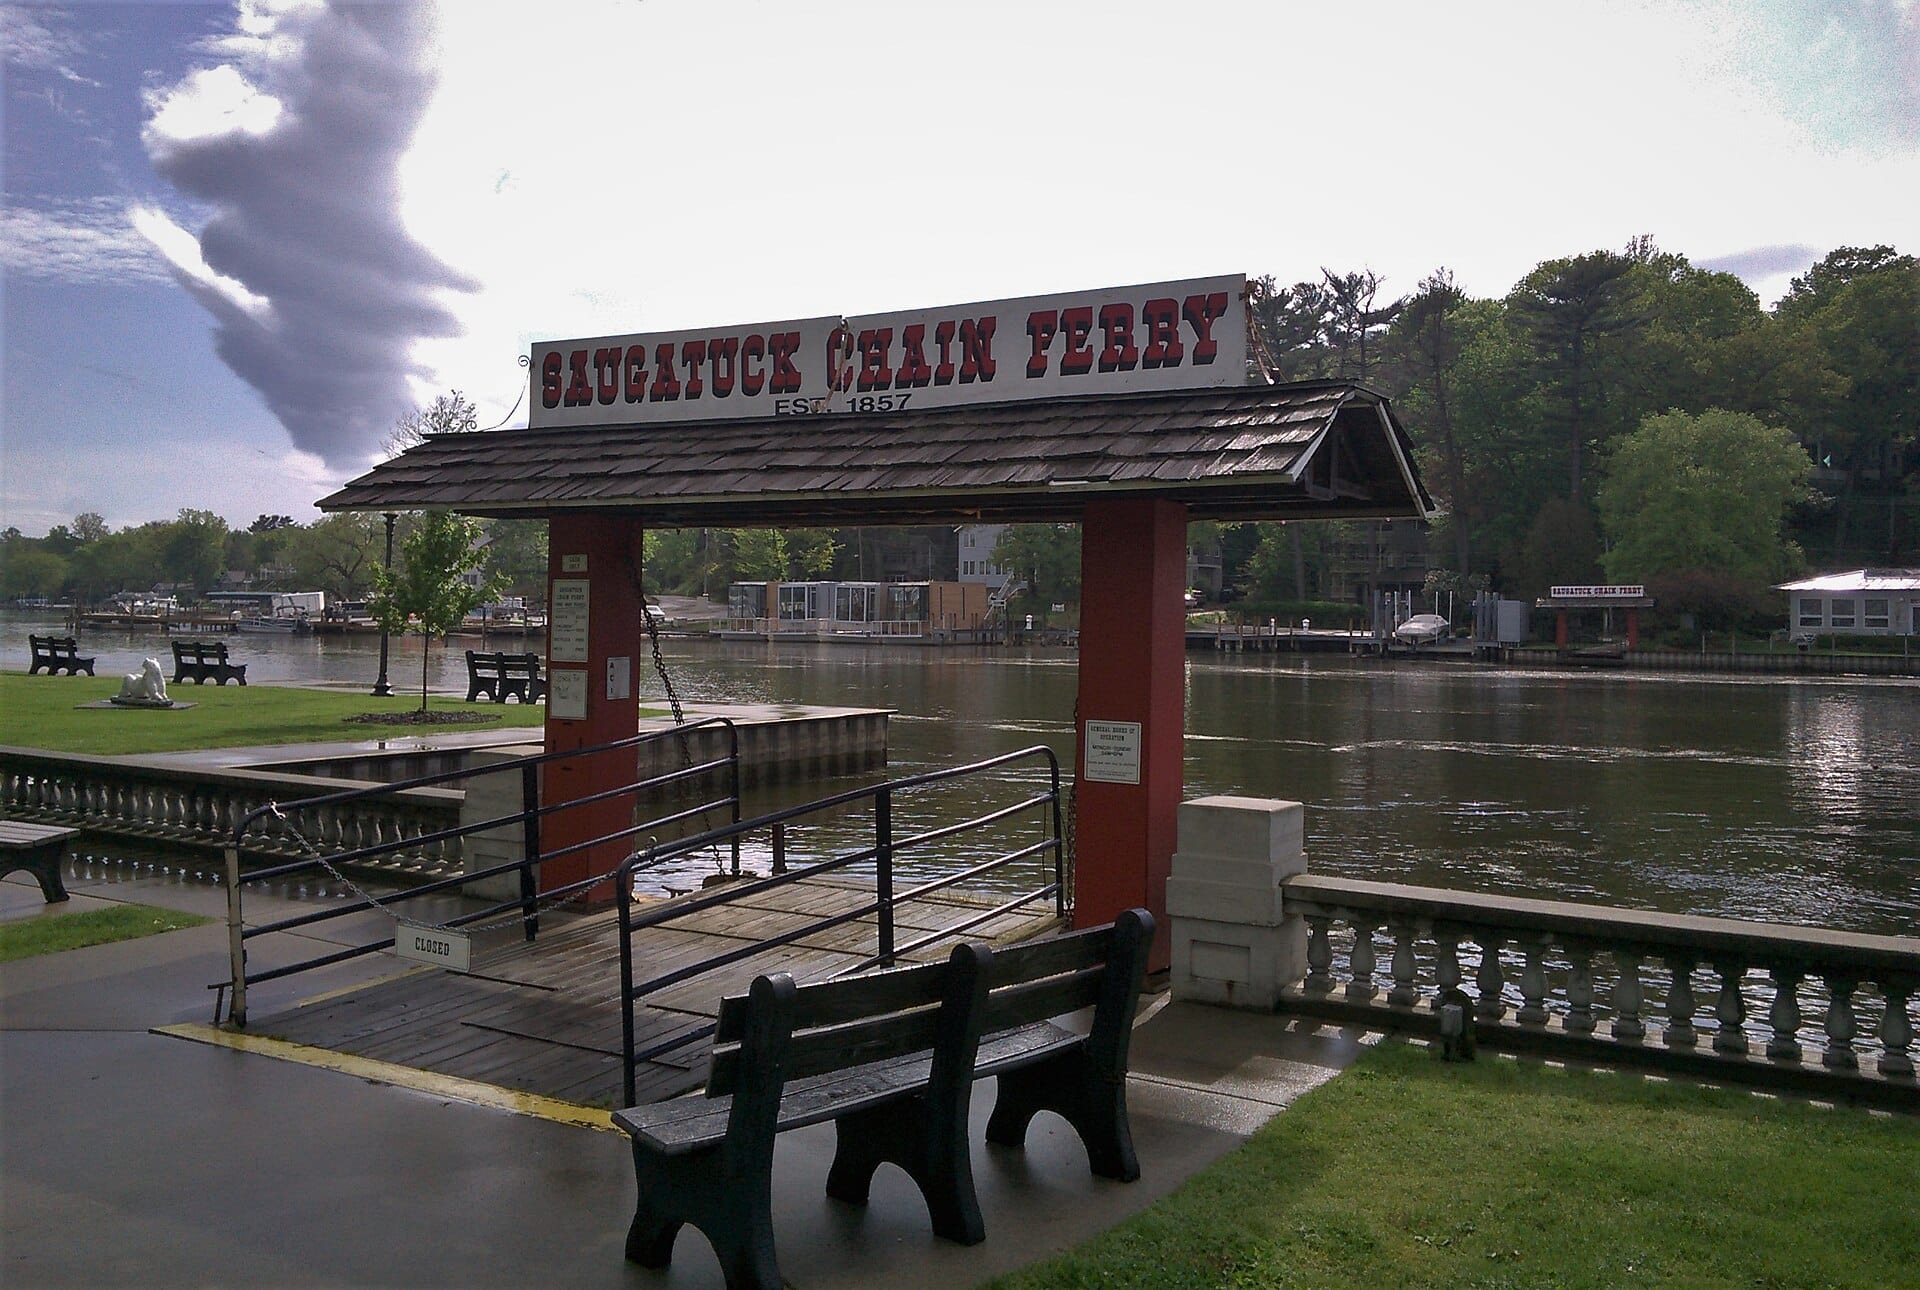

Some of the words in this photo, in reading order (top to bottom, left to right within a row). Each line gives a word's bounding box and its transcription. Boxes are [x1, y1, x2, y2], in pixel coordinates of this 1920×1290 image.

[542, 331, 801, 409] SAUGATUCK
[826, 316, 997, 394] CHAIN
[1026, 292, 1229, 379] FERRY
[846, 393, 912, 413] 1857
[415, 937, 450, 956] CLOSED
